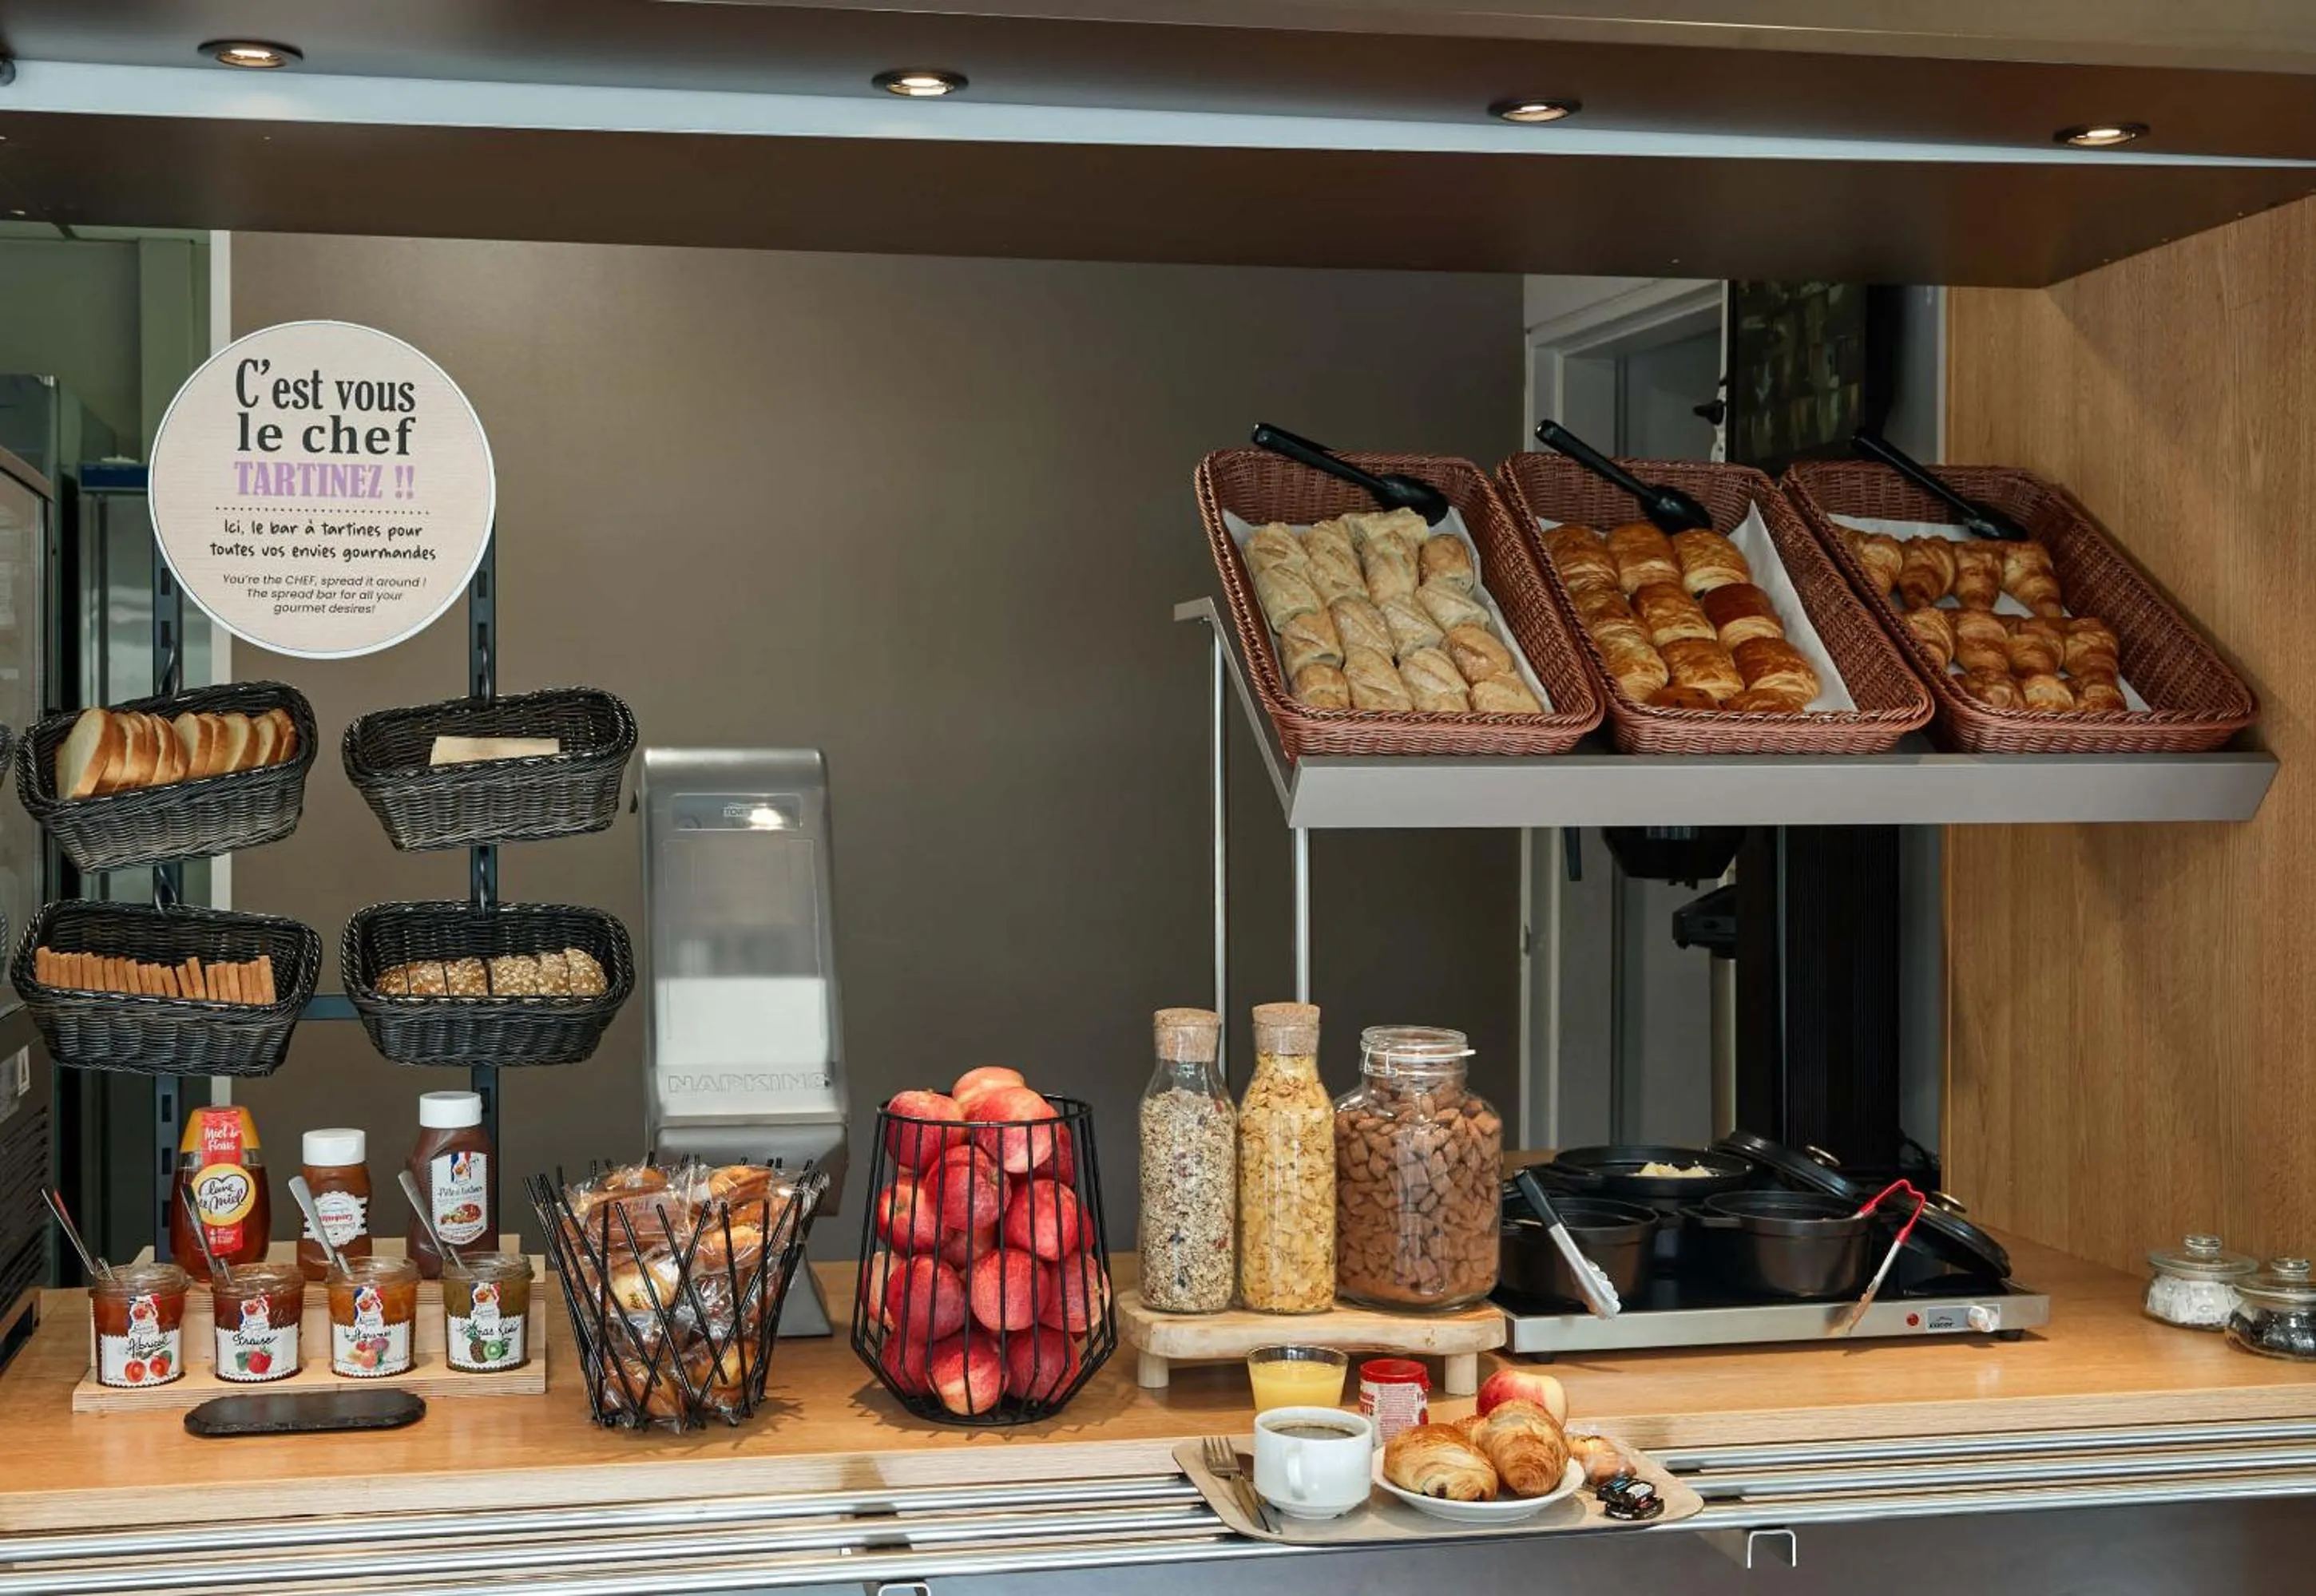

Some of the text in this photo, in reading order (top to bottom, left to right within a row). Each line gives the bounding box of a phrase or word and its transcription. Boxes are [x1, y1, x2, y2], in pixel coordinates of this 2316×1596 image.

[236, 358, 416, 412] C'est vous
[237, 412, 416, 455] le chef
[234, 461, 414, 500] TARTINEZ !!
[252, 521, 264, 535] le
[270, 521, 298, 534] bar
[305, 519, 315, 534] à
[321, 522, 381, 537] tartines
[388, 526, 422, 541] pour
[209, 542, 436, 562] toutes vos envies gourmandes
[224, 574, 260, 584] You're
[264, 575, 283, 584] the
[285, 575, 317, 587] CHEF,
[321, 576, 363, 588] spread
[366, 577, 374, 586] it
[376, 577, 420, 588] around
[247, 589, 403, 603] The spread bar for all your
[274, 604, 376, 616] gourmet desires!
